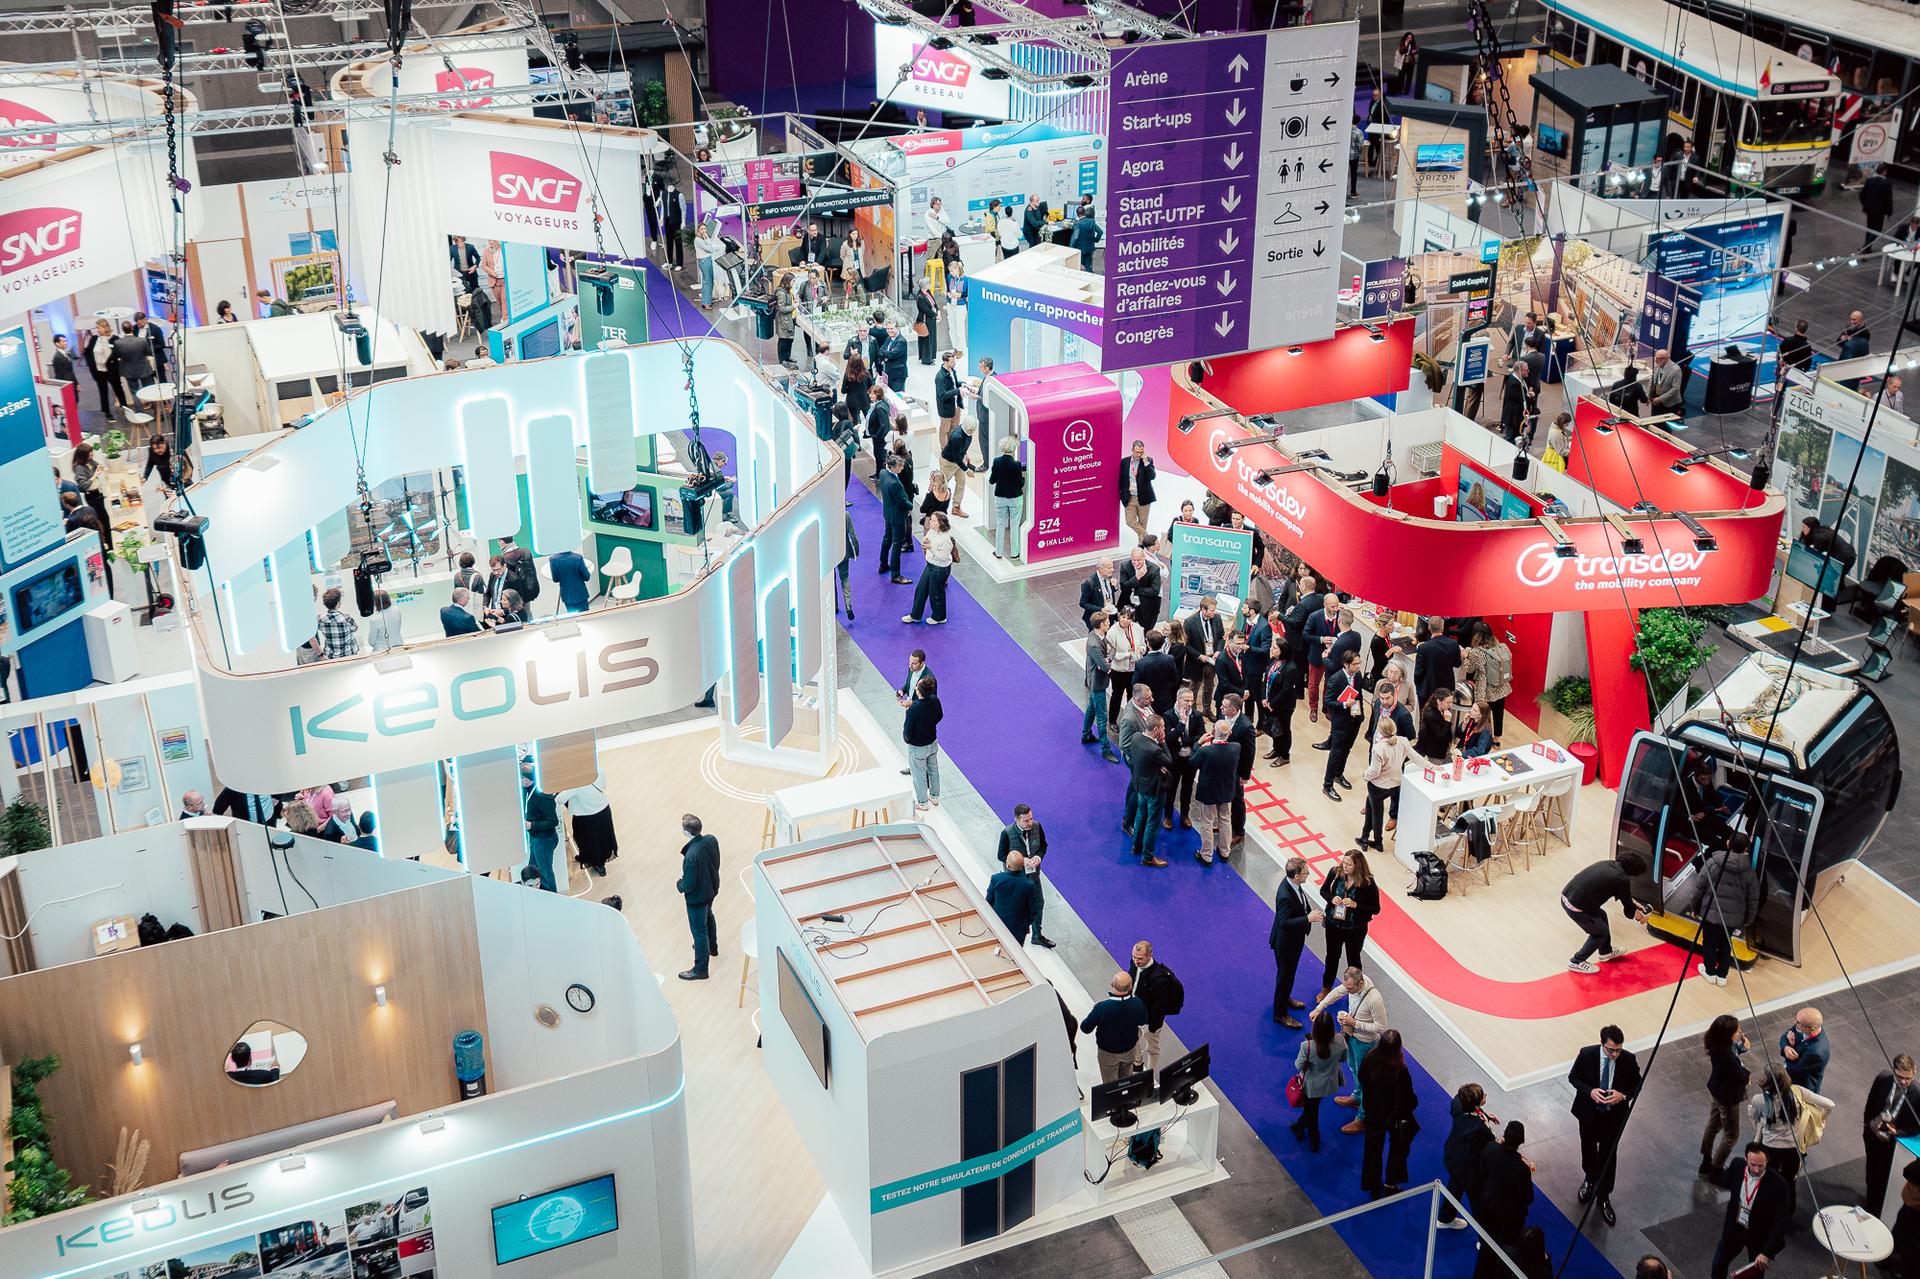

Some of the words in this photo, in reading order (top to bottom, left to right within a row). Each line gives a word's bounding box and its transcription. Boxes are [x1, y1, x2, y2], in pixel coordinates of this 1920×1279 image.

[914, 58, 968, 81] SNCF
[1124, 71, 1168, 88] Arène
[1122, 111, 1192, 131] Start-ups
[1121, 160, 1164, 176] Agora
[296, 185, 342, 198] cristal
[496, 174, 576, 204] SNCF
[765, 206, 779, 214] INFO
[816, 198, 848, 208] PROMOTION
[1120, 194, 1163, 212] Stand
[494, 210, 578, 230] VOYAGEURS
[1119, 204, 1206, 228] GART-UTPF
[1, 216, 79, 267] SNCF
[1118, 236, 1185, 256] Mobilités
[1486, 246, 1498, 254] BUS
[1118, 254, 1168, 273] actives
[1268, 246, 1304, 262] Sortie
[3, 258, 85, 294] VOYAGEURS
[1116, 274, 1206, 296] Rendez-vous
[1452, 276, 1488, 288] Saint-Exupéry
[982, 287, 1032, 311] Innover,
[601, 326, 627, 340] TER
[1116, 324, 1174, 345] Congrès
[1790, 394, 1823, 419] ZICLA
[1070, 430, 1086, 442] ici
[1060, 465, 1078, 474] votre
[1078, 460, 1102, 470] écoute
[1074, 454, 1094, 463] agent
[1238, 482, 1248, 496] the
[1248, 492, 1275, 517] mobility
[1275, 510, 1304, 538] company
[1039, 517, 1060, 530] 574
[1182, 532, 1242, 549] transamo
[1575, 549, 1706, 576] transdev
[1575, 580, 1595, 590] the
[1597, 578, 1646, 589] mobility
[1648, 576, 1702, 588] company
[880, 1186, 912, 1202] TESTEZ
[912, 1179, 940, 1192] NOTRE
[941, 1164, 990, 1184] SIMULATEUR
[992, 1160, 1002, 1169] DE
[1002, 1142, 1036, 1165] CONDUITE
[1036, 1137, 1046, 1146] DE
[1046, 1118, 1079, 1140] TRAMWAY
